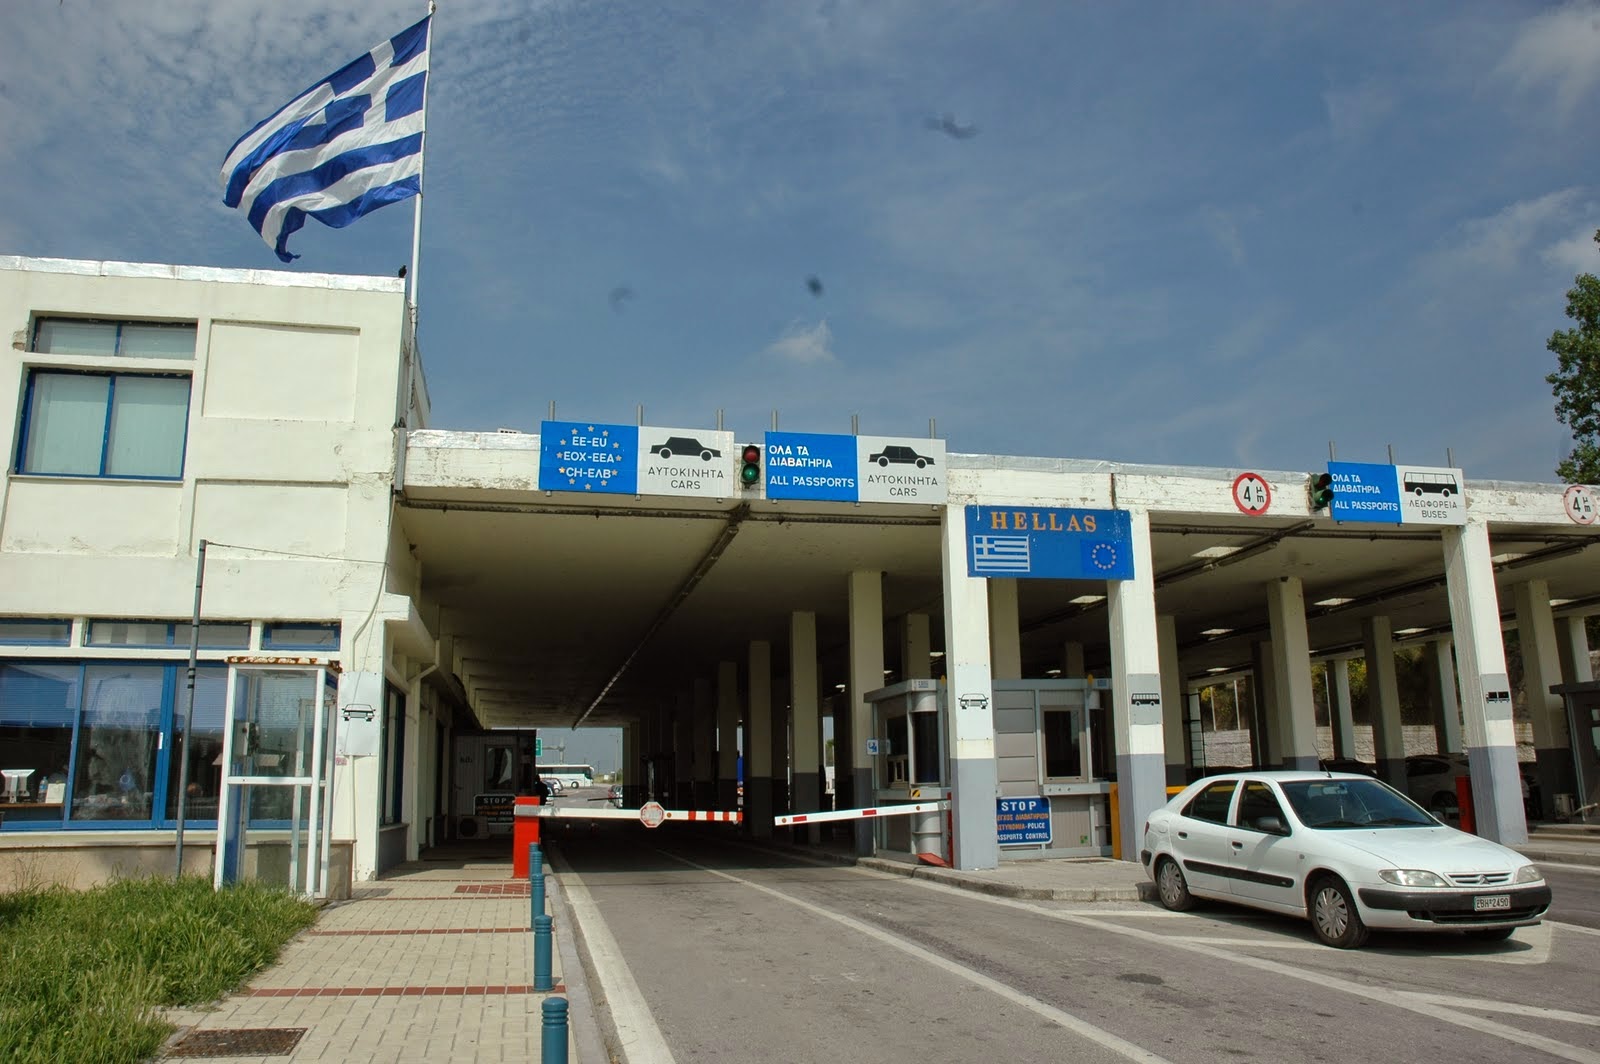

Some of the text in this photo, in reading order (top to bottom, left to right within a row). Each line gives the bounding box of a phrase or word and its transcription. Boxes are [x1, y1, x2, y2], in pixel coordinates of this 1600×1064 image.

[769, 445, 809, 456] ΟΛΑ ΤΑ
[769, 457, 833, 468] ΔΙΑΒΑΤΗΡΙΑ
[648, 466, 724, 479] ΑΥΤΟΚΙΝΗΤΑ
[769, 475, 855, 488] ALL PASSPORTS
[868, 474, 938, 486] ΑΥΤΟΚΙΝΗΤΑ
[1331, 473, 1350, 483] ΟΛΑ
[671, 480, 701, 489] CARS
[1332, 484, 1381, 494] ΔΙΑΒΑΤΗΡΙΑ
[889, 487, 918, 497] CARS
[1243, 485, 1251, 502] 4
[1335, 501, 1399, 511] ALL PASSPORTS
[1409, 500, 1458, 509] ΛΕΩΦΟΡΕΙΑ
[1572, 496, 1581, 512] 4
[1421, 510, 1448, 519] BUSES
[990, 511, 1097, 533] HELLAS
[1001, 801, 1037, 811] STOP
[1025, 832, 1049, 840] CONTROL
